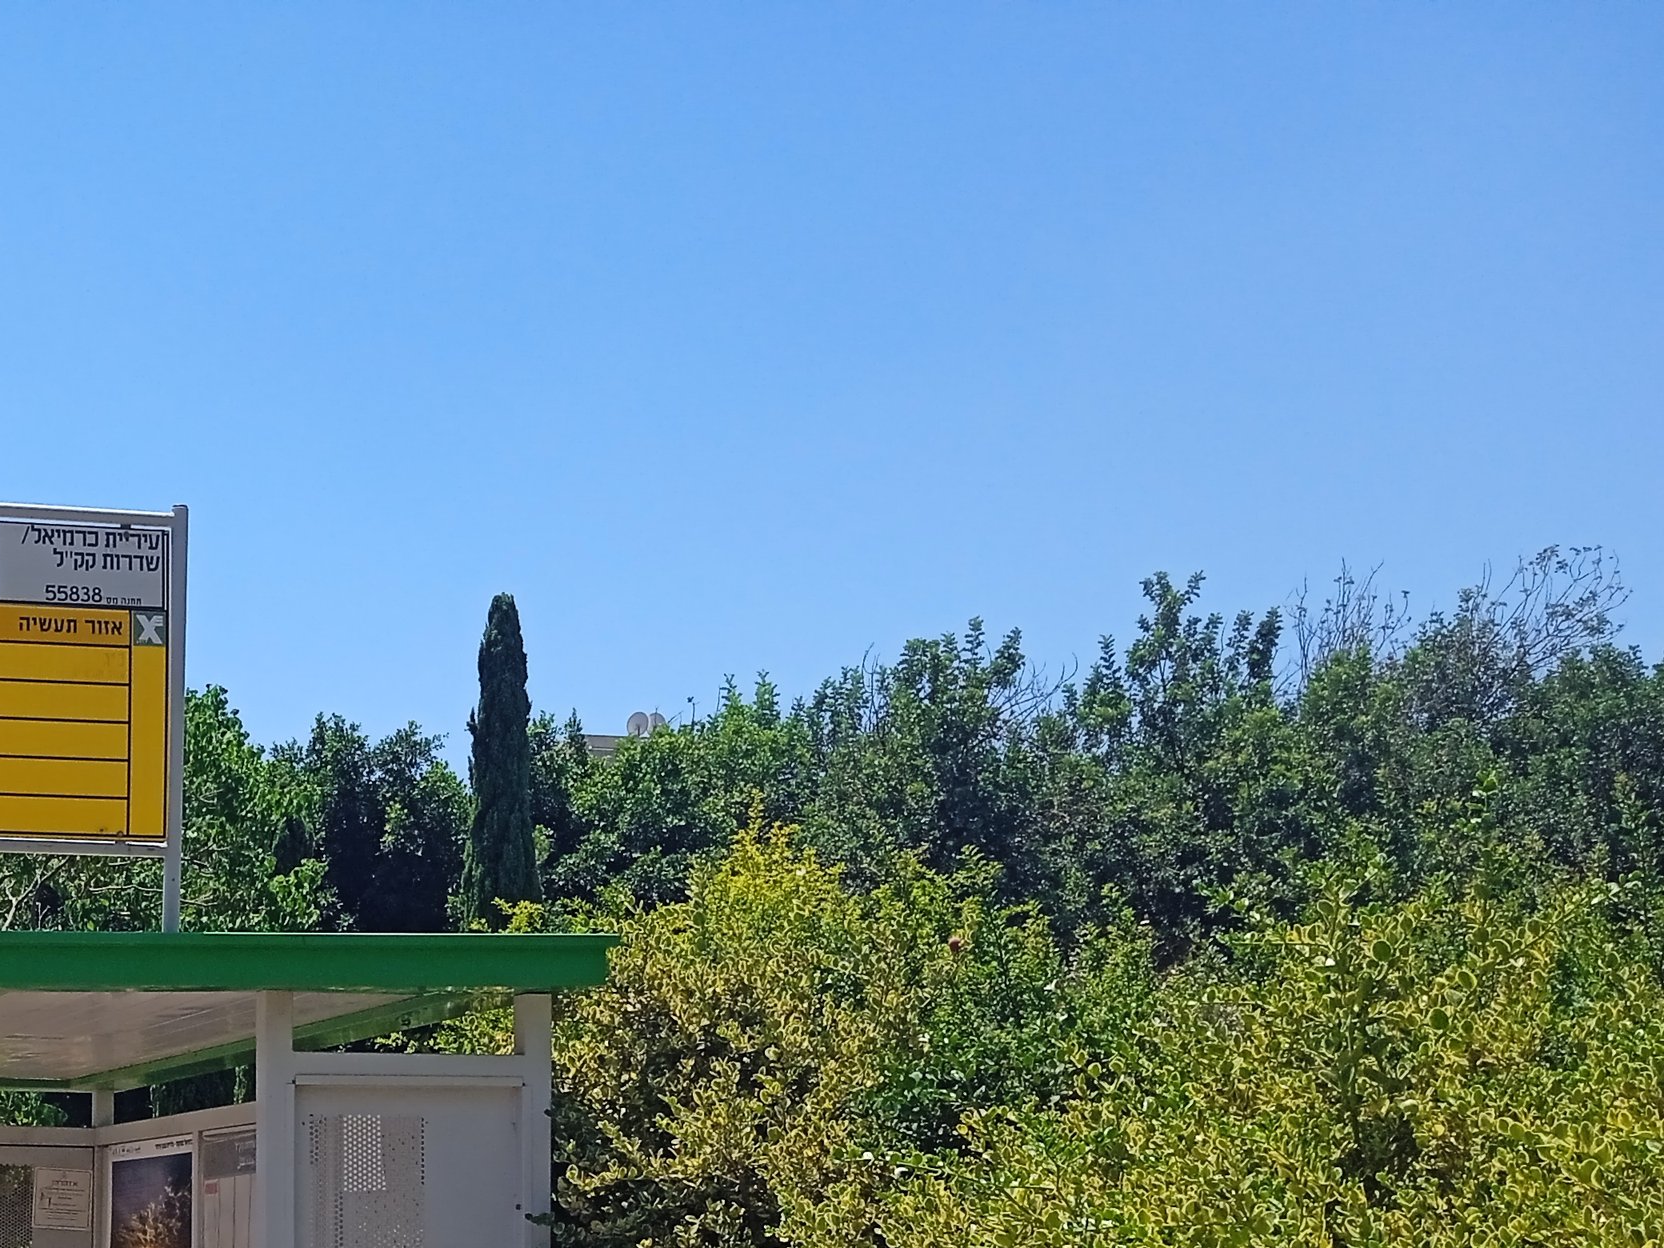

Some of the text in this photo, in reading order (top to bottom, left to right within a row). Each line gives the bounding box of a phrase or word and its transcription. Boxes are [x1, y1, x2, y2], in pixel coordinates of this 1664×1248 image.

[102, 552, 160, 572] שדרות
[45, 584, 103, 603] 55838
[18, 616, 123, 636] אזור תעשיה
